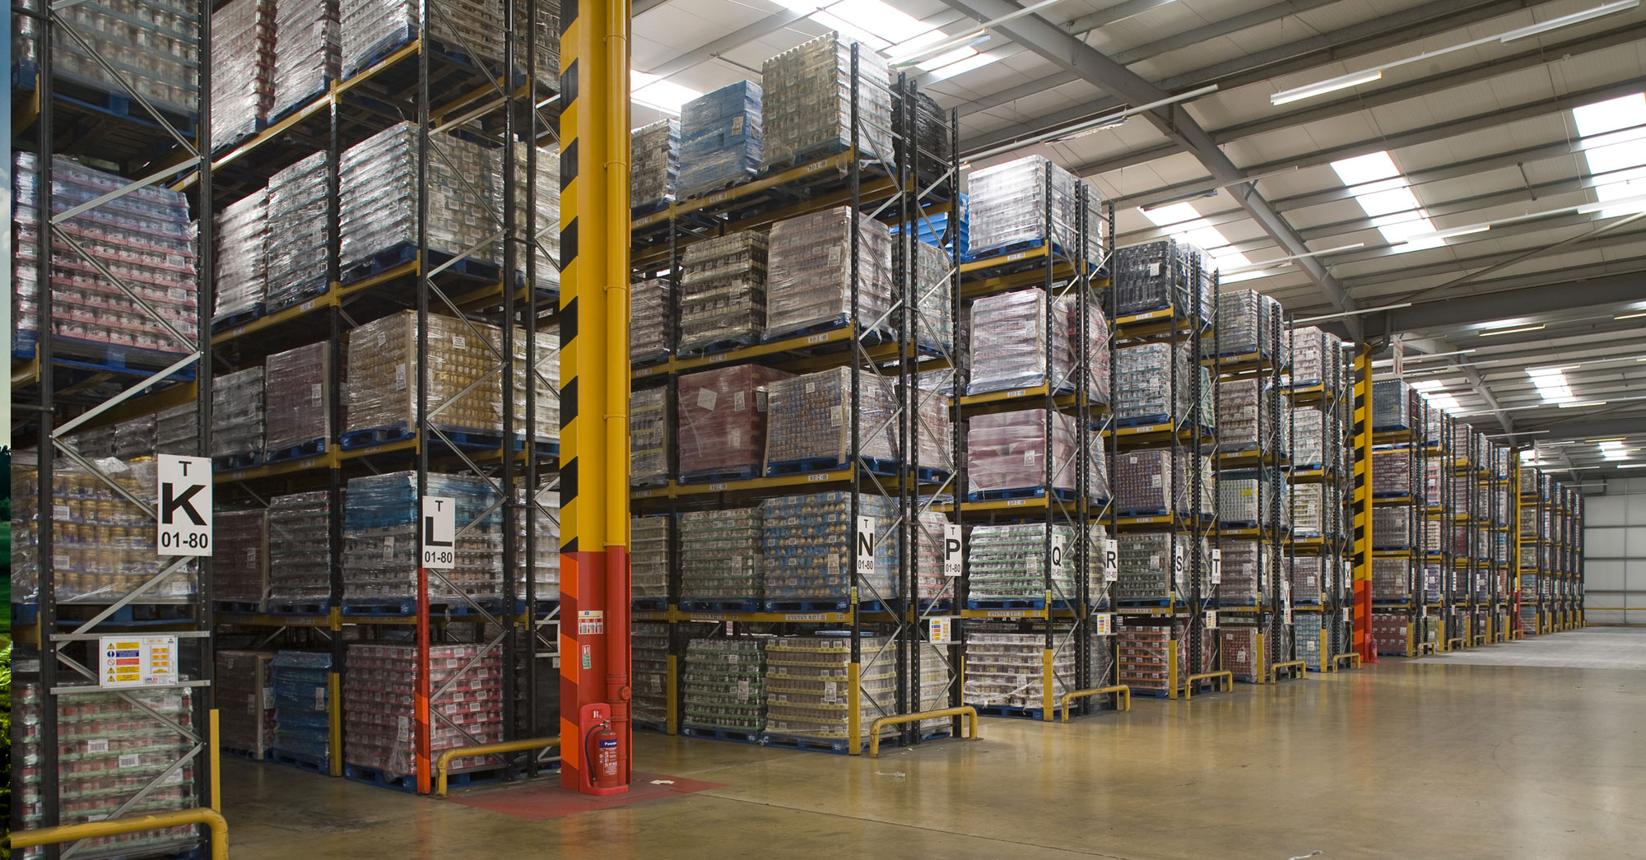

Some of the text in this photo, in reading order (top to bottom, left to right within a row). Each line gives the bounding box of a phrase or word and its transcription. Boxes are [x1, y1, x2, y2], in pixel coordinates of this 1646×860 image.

[179, 461, 192, 476] T
[162, 482, 207, 526] K
[435, 500, 443, 512] T
[425, 516, 452, 546] L
[864, 519, 868, 528] T
[950, 527, 955, 535] T
[162, 532, 208, 548] 01-80
[858, 532, 873, 556] N
[946, 538, 960, 560] P
[1052, 546, 1061, 566] Q
[425, 551, 452, 563] 01-80
[1106, 551, 1116, 568] R
[1176, 555, 1182, 572] S
[858, 560, 873, 570] 01-80
[946, 564, 960, 572] 01-80
[1213, 559, 1220, 574] T
